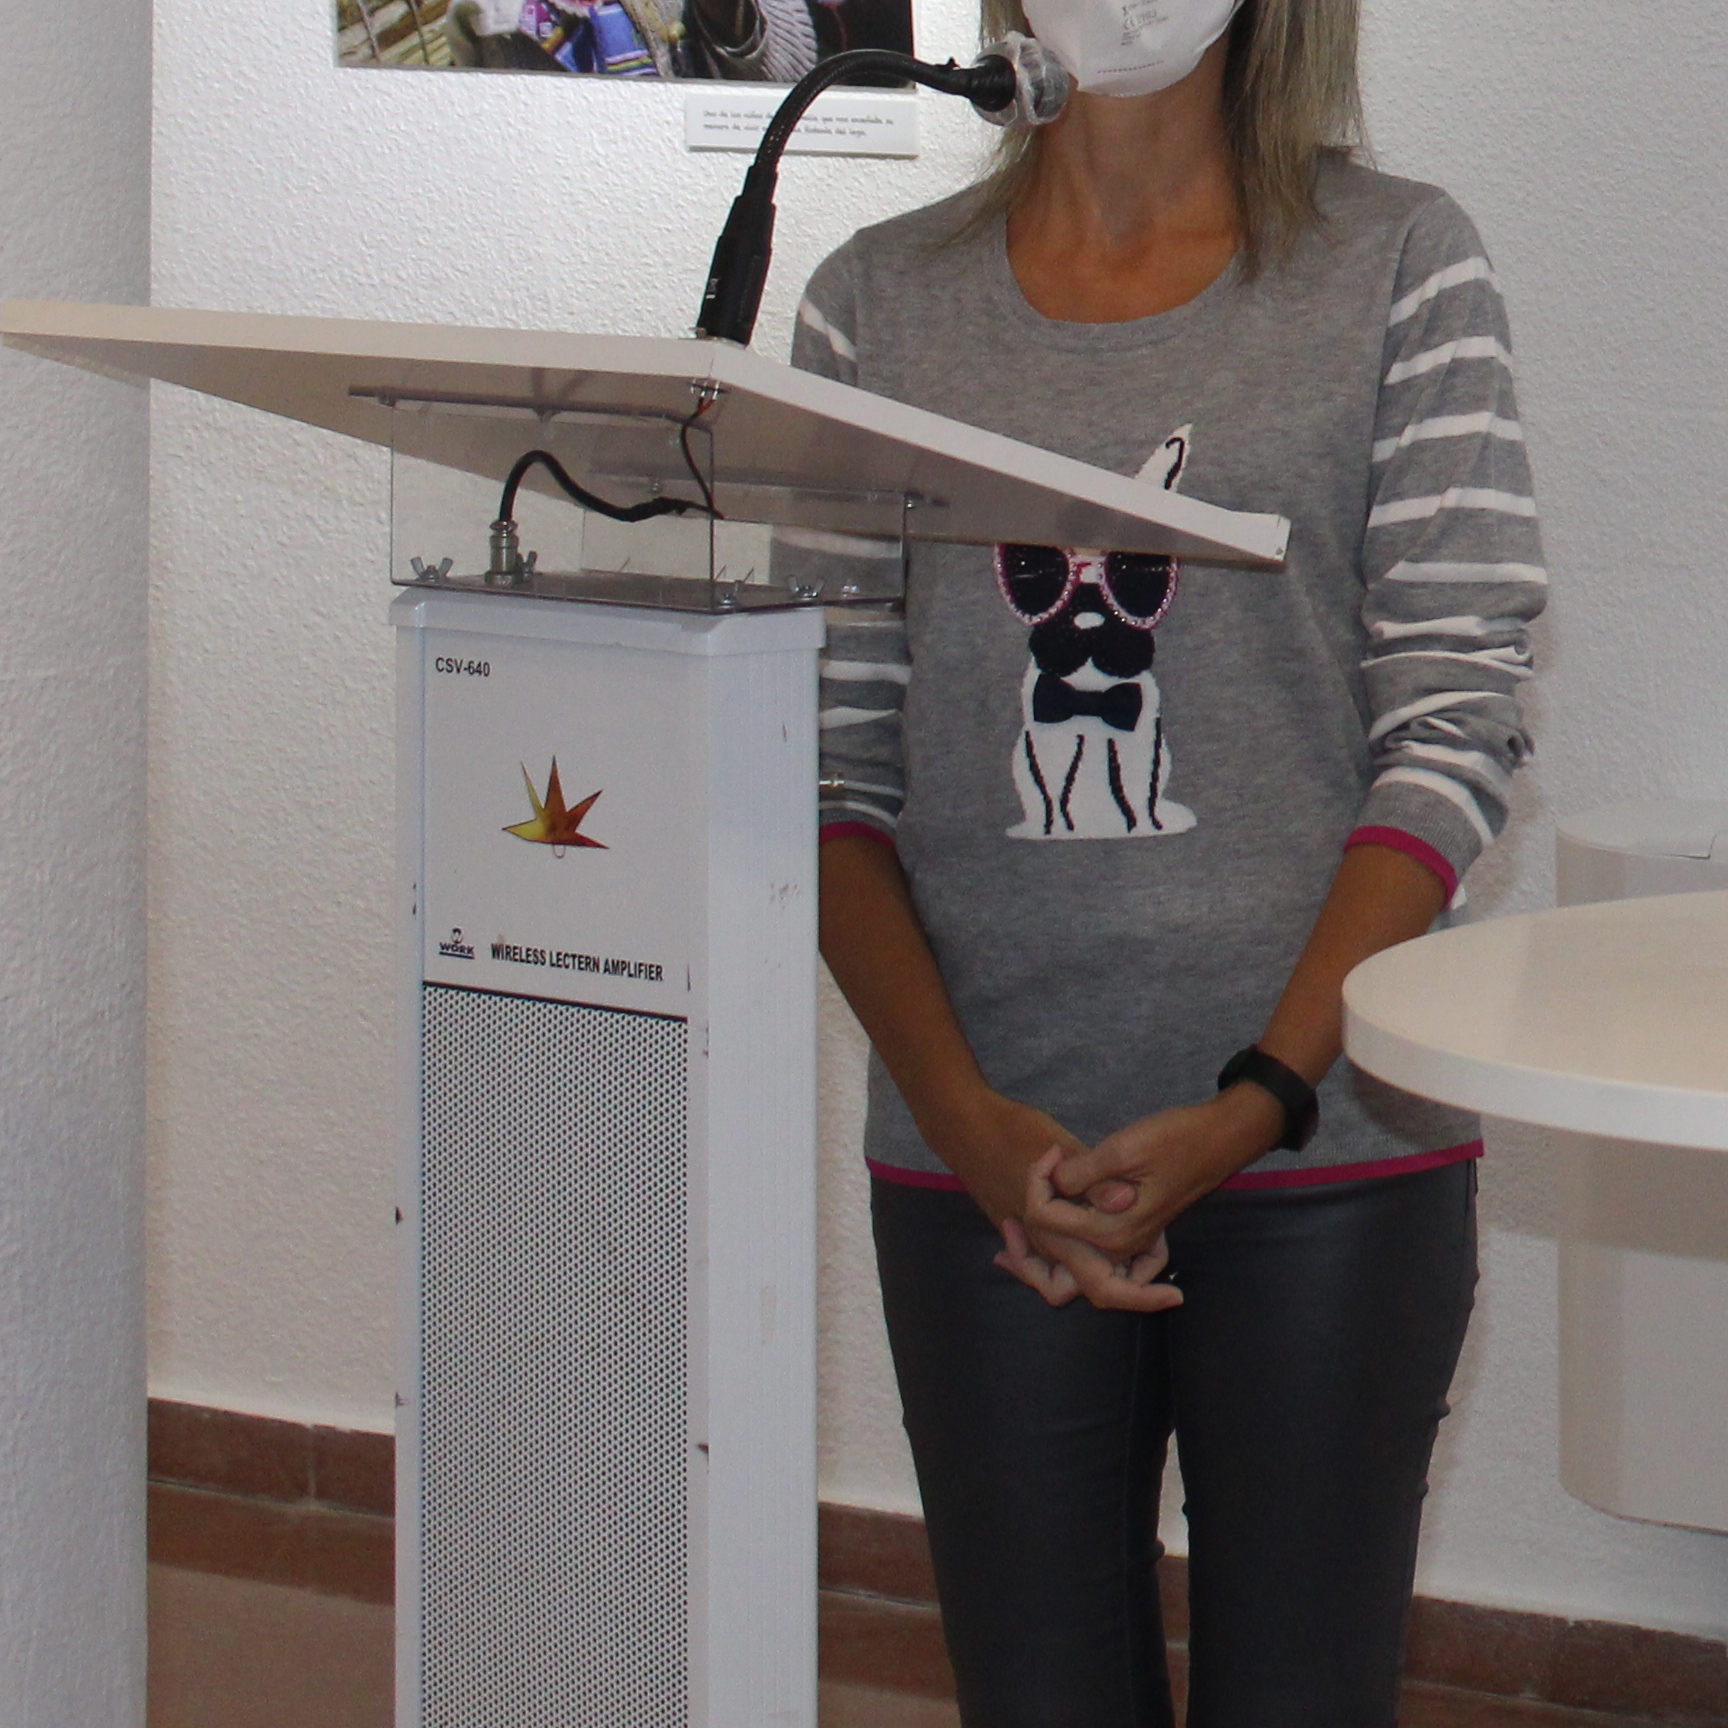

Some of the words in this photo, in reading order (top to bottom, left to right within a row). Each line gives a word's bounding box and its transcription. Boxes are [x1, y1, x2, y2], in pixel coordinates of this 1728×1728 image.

[435, 657, 491, 678] CSV-640
[439, 942, 475, 955] WORK
[491, 943, 547, 966] WIRELESS
[550, 950, 600, 973] LECTERN
[603, 958, 663, 981] AMPLIFIER
